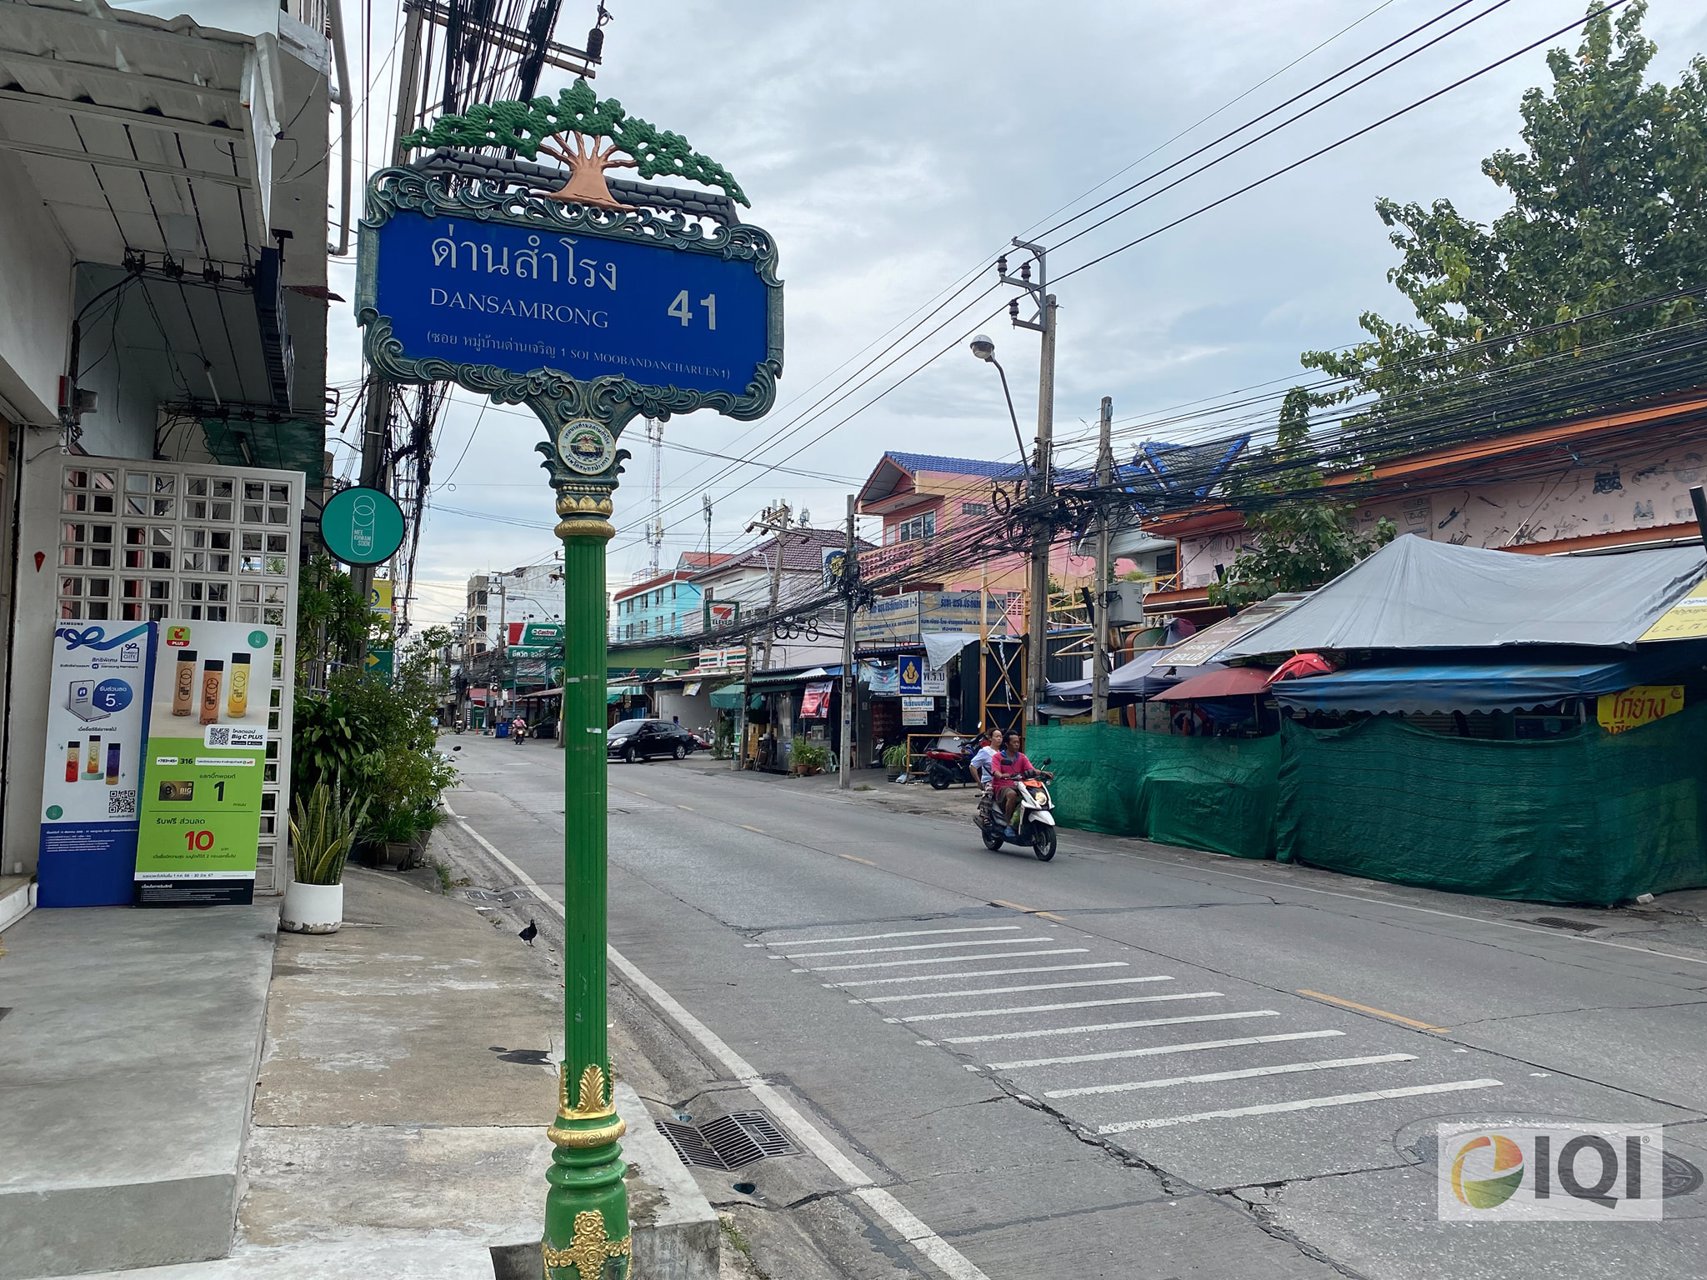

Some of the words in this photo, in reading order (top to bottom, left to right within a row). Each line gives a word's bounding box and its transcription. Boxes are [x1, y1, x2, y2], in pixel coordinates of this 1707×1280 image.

[431, 223, 618, 291] ด่านสำโรง
[429, 287, 610, 329] DANSAMRONG
[667, 289, 717, 331] 41
[427, 329, 458, 345] (ซอย
[463, 334, 556, 360] หมู่บ้านด่านเจริญ
[560, 347, 566, 358] 1
[570, 349, 590, 361] SOI
[1612, 690, 1666, 719] ไก่ย่าง
[213, 780, 225, 802] 1
[156, 817, 177, 825] รับฟรี
[179, 817, 206, 825] ส่วนลด
[184, 830, 215, 851] 10
